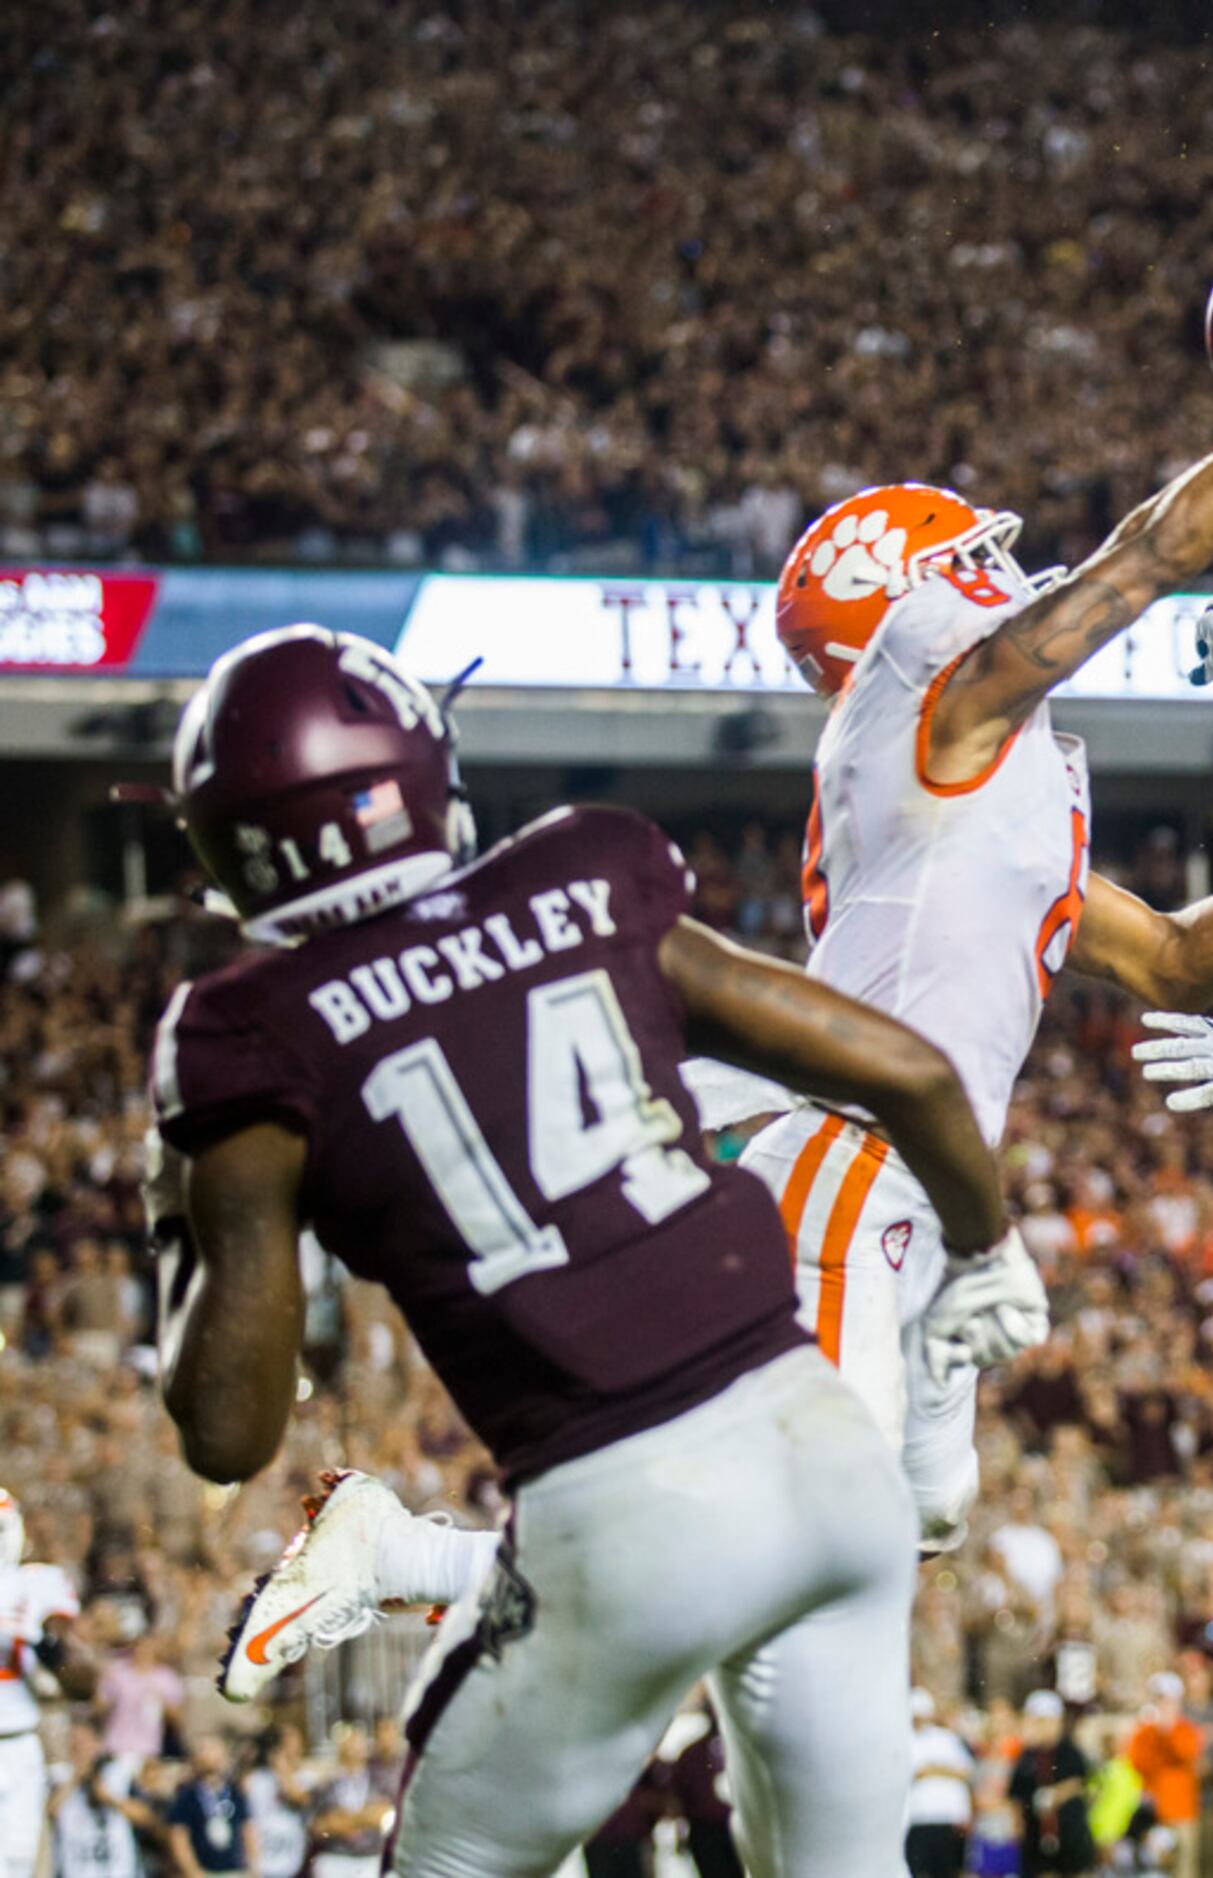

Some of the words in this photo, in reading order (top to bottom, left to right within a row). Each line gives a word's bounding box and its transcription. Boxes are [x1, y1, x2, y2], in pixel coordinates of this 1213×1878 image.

[280, 821, 353, 881] 14
[308, 879, 618, 1045] BUCKLEY
[361, 968, 711, 1297] 14
